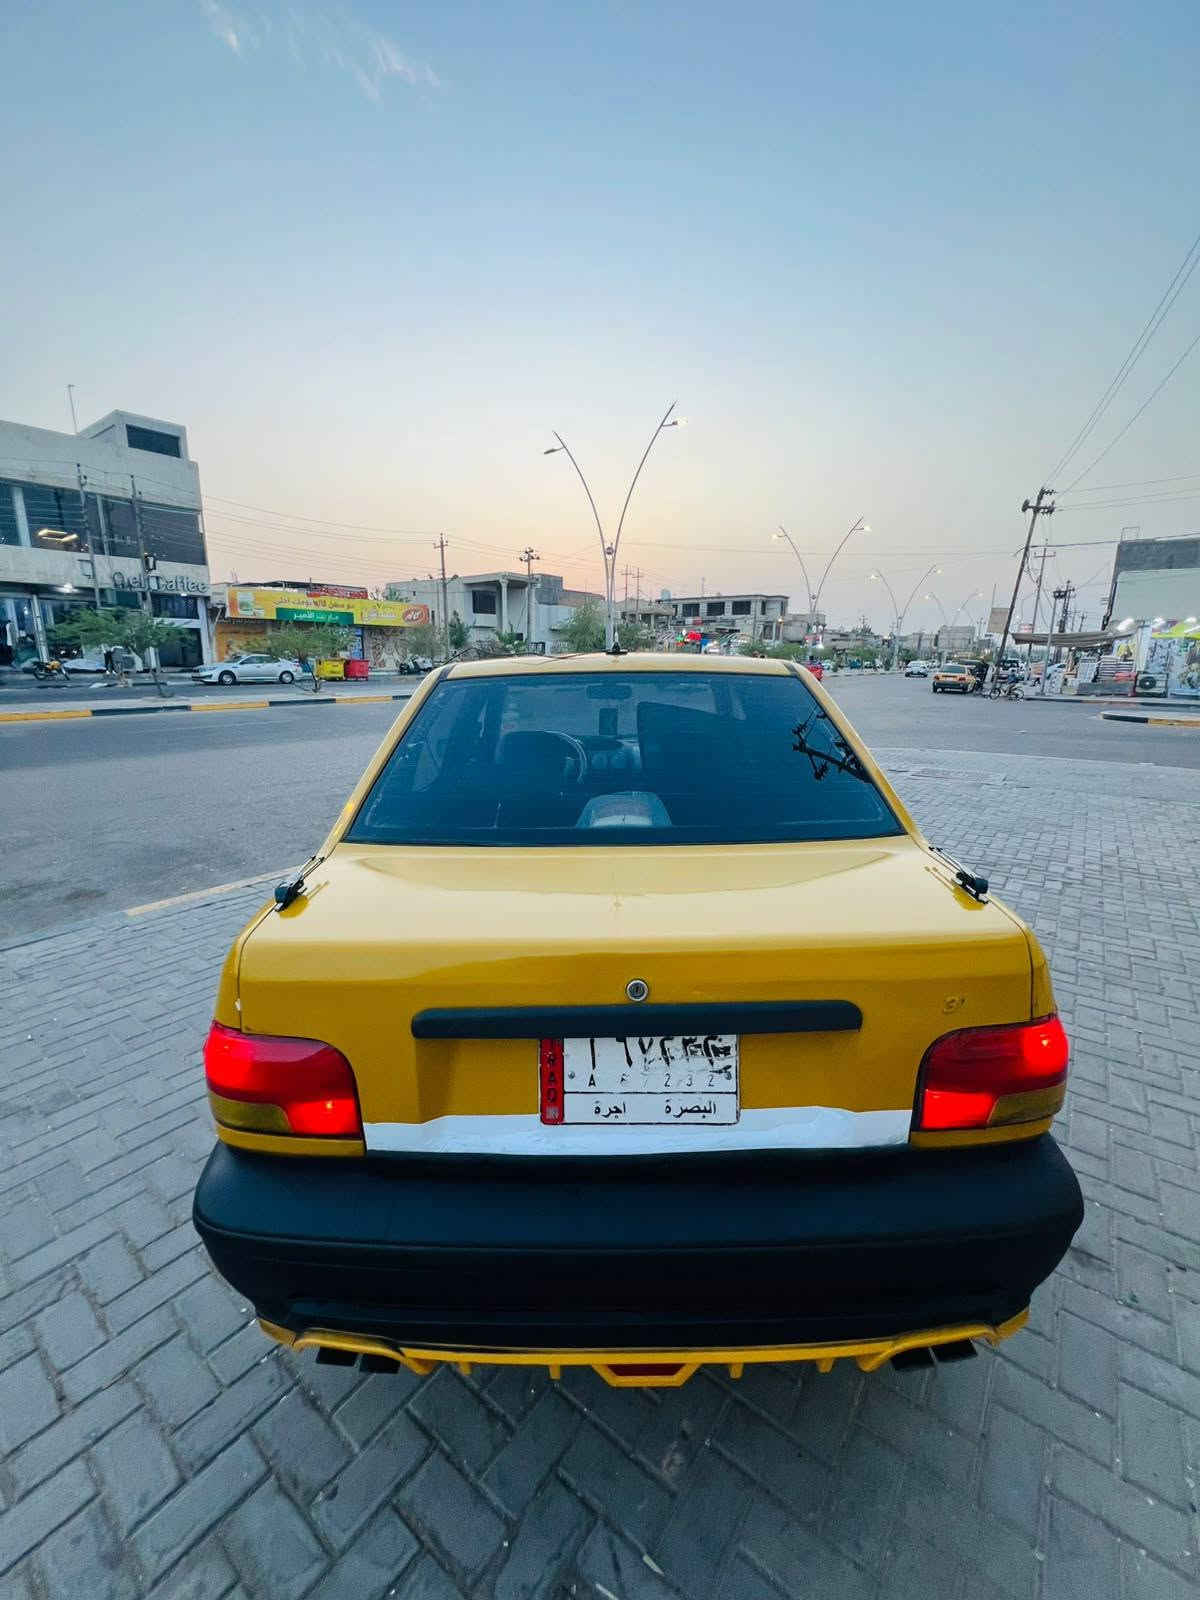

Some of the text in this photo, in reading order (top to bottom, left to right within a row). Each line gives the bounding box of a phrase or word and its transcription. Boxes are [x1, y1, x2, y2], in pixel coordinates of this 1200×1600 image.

[588, 1074, 597, 1087] A
[594, 1100, 717, 1119] البصرة اجرة
